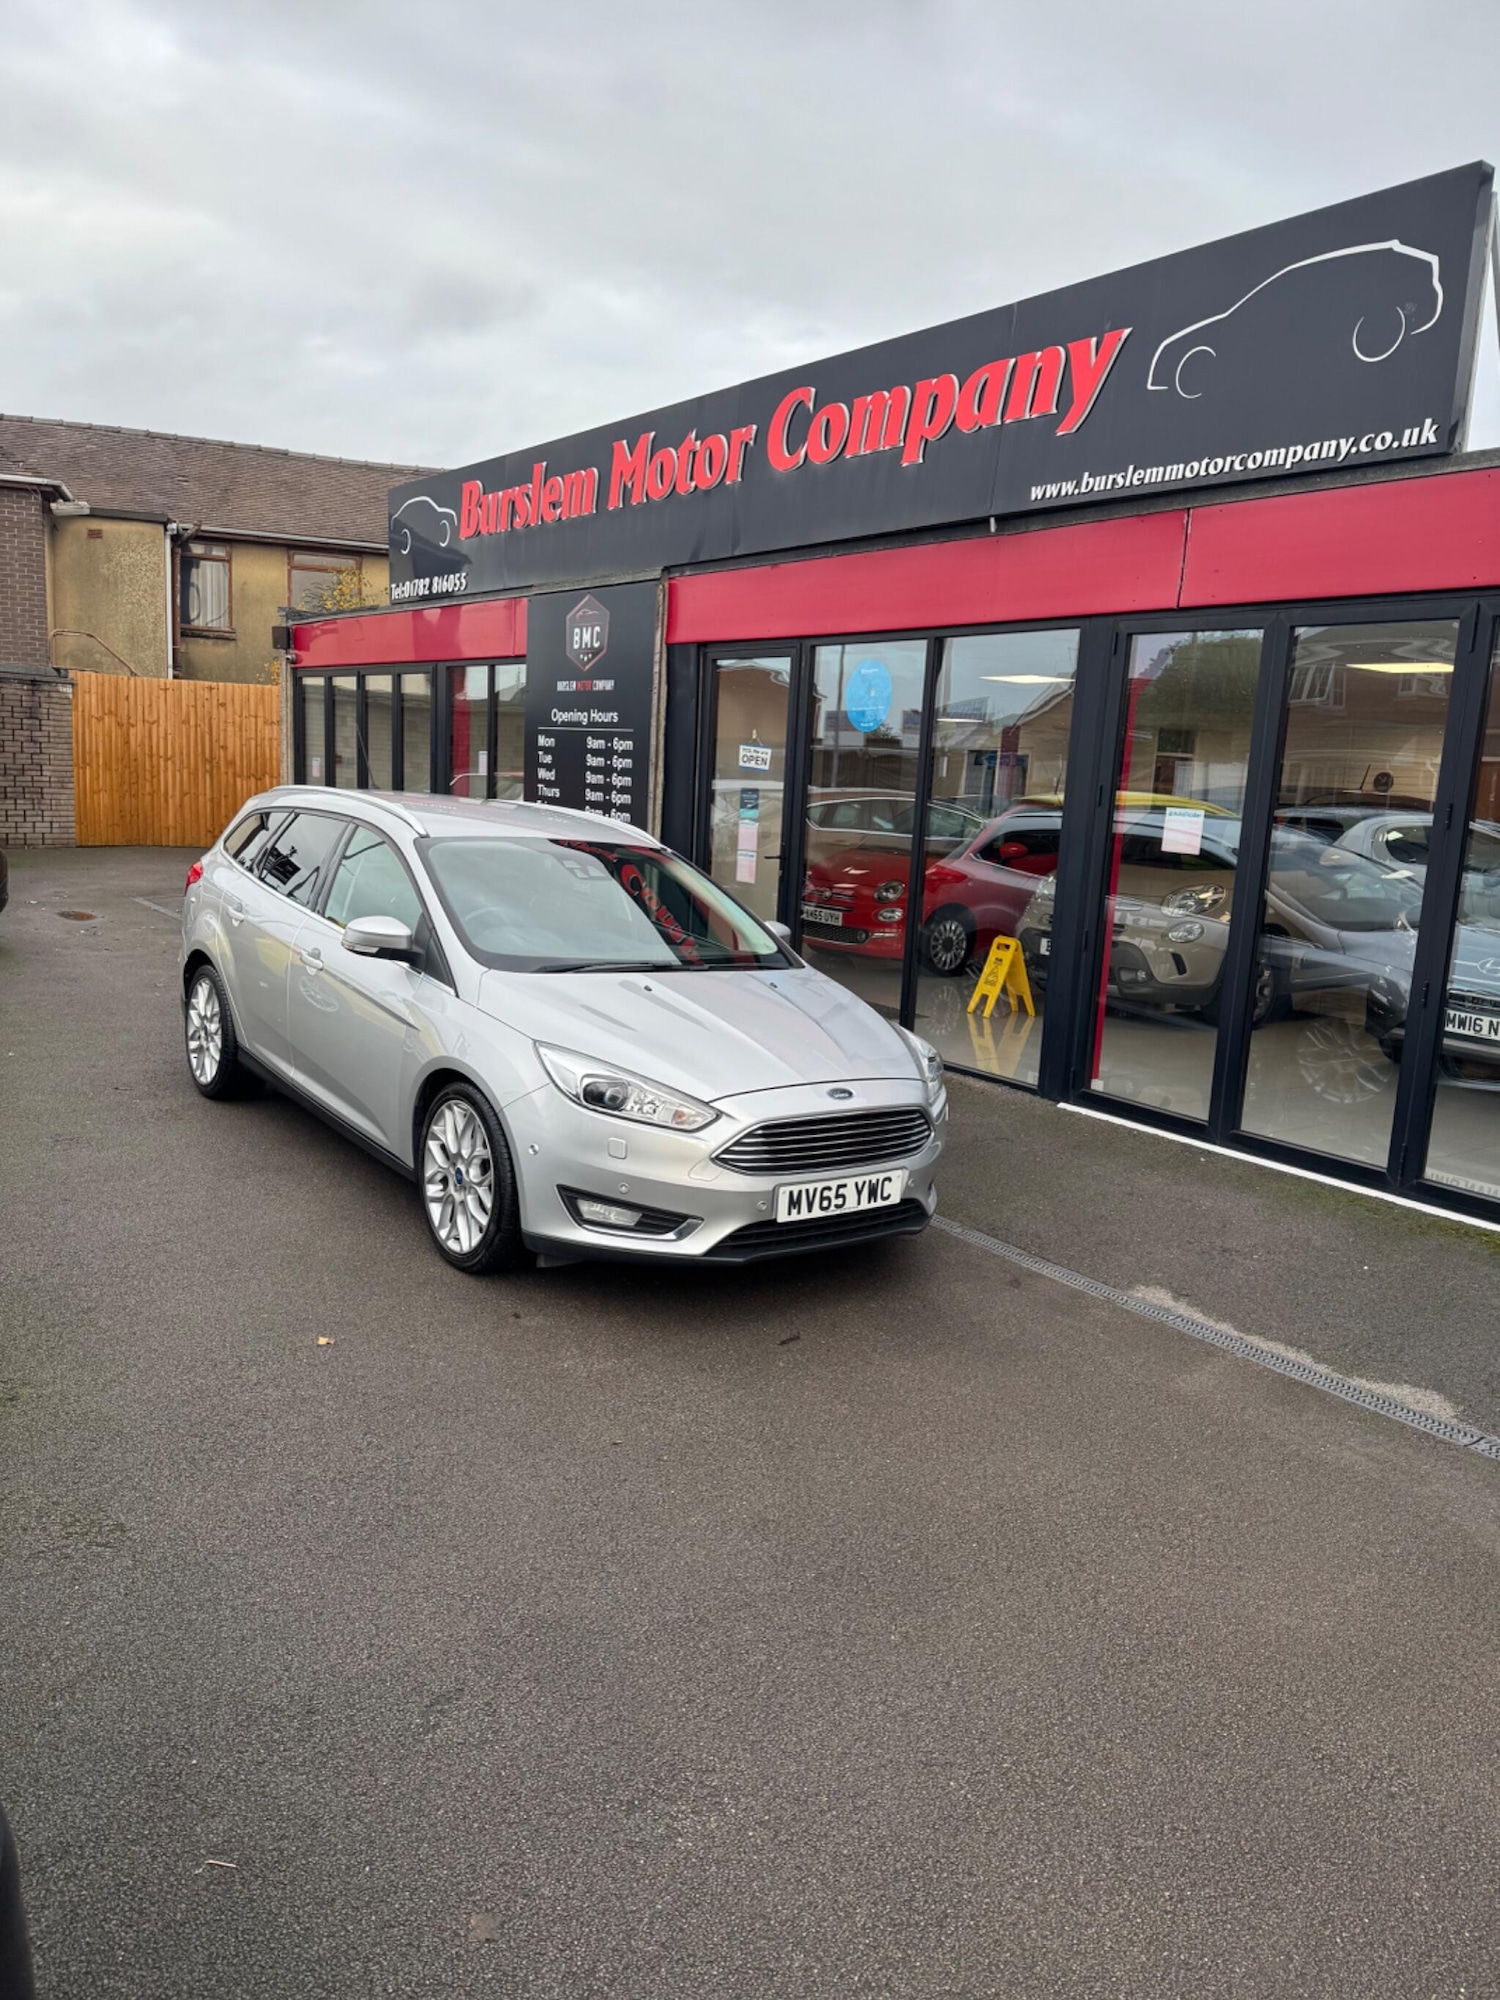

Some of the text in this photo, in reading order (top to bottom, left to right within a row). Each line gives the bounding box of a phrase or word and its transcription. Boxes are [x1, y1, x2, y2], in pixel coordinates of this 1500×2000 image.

[459, 327, 1133, 540] Burslem Motor Company
[1030, 418, 1439, 501] www.burslemmotorcompany.co.uk
[391, 572, 468, 600] Tel:01782 816055
[573, 626, 601, 650] BMC
[551, 708, 619, 725] Opening Hours
[537, 734, 555, 747] Mon
[586, 736, 606, 750] 9am
[613, 737, 633, 753] 6pm
[538, 751, 552, 763] Tue
[586, 753, 605, 766] 9am
[612, 754, 632, 770] 6pm
[742, 753, 768, 766] OPEN
[537, 768, 555, 781] Wed
[585, 771, 604, 784] 9am
[611, 772, 632, 788] 6pm
[537, 783, 560, 797] Thurs
[585, 788, 604, 801] 9am
[611, 790, 631, 806] 6pm
[1446, 1012, 1484, 1033] MW16
[787, 1176, 893, 1216] MV65 YWC
